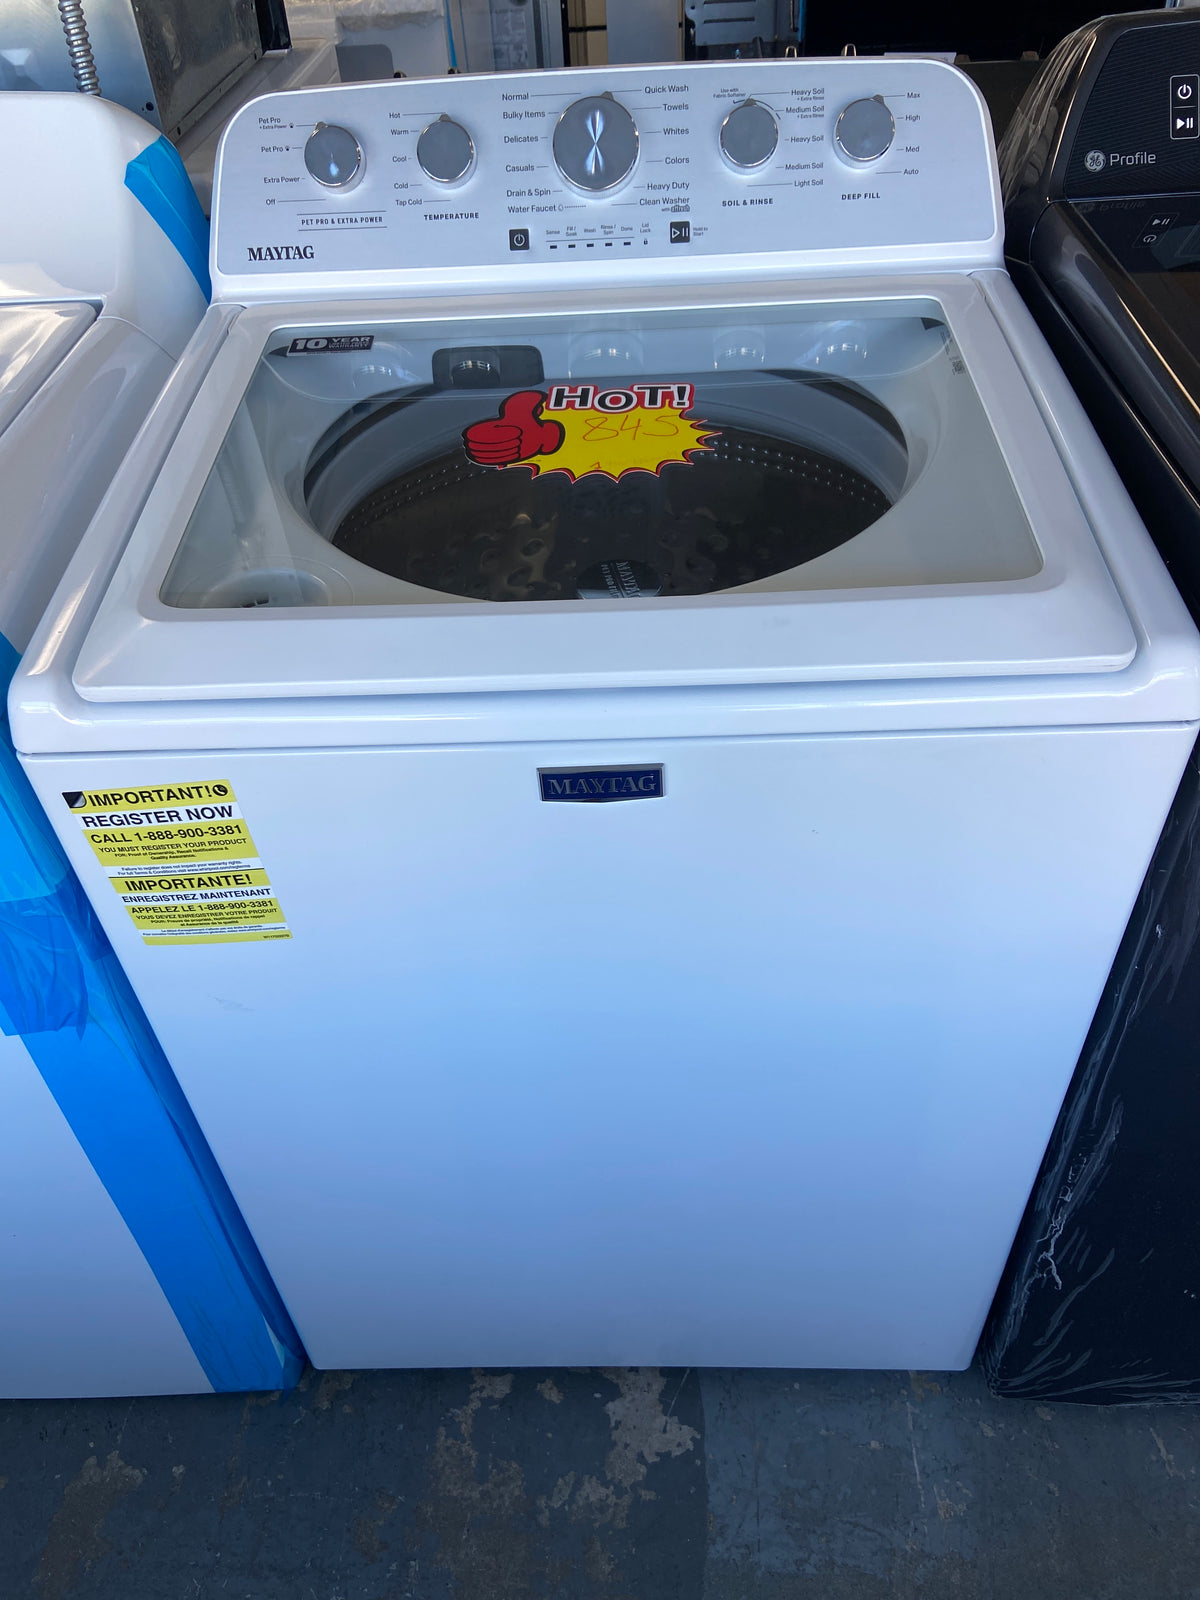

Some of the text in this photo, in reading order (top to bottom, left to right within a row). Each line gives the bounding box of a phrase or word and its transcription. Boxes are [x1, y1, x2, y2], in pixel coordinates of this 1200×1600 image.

[502, 93, 529, 101] Normal
[663, 103, 689, 111] Towels
[503, 112, 523, 120] Bulky
[504, 135, 538, 144] Delicates
[1110, 152, 1156, 166] Profile
[506, 164, 534, 172] Casuals
[672, 182, 690, 190] Duty
[506, 189, 526, 197] Drain
[534, 188, 551, 197] Spin
[662, 197, 690, 205] Washer
[424, 212, 479, 220] TEMPERATURE
[248, 246, 314, 262] MAYTAG
[296, 338, 328, 349] 10
[582, 414, 680, 442] 845
[548, 774, 656, 795] MAYTAG
[88, 785, 212, 806] IMPORTANT!
[82, 805, 232, 827] REGISTER NOW
[91, 825, 242, 843] CALL 1-888-900-3381
[124, 874, 252, 891] IMPORTANTE!
[122, 888, 270, 902] ENREGISTREZ MAINTENANT
[198, 900, 273, 910] 1-888-900-3381
